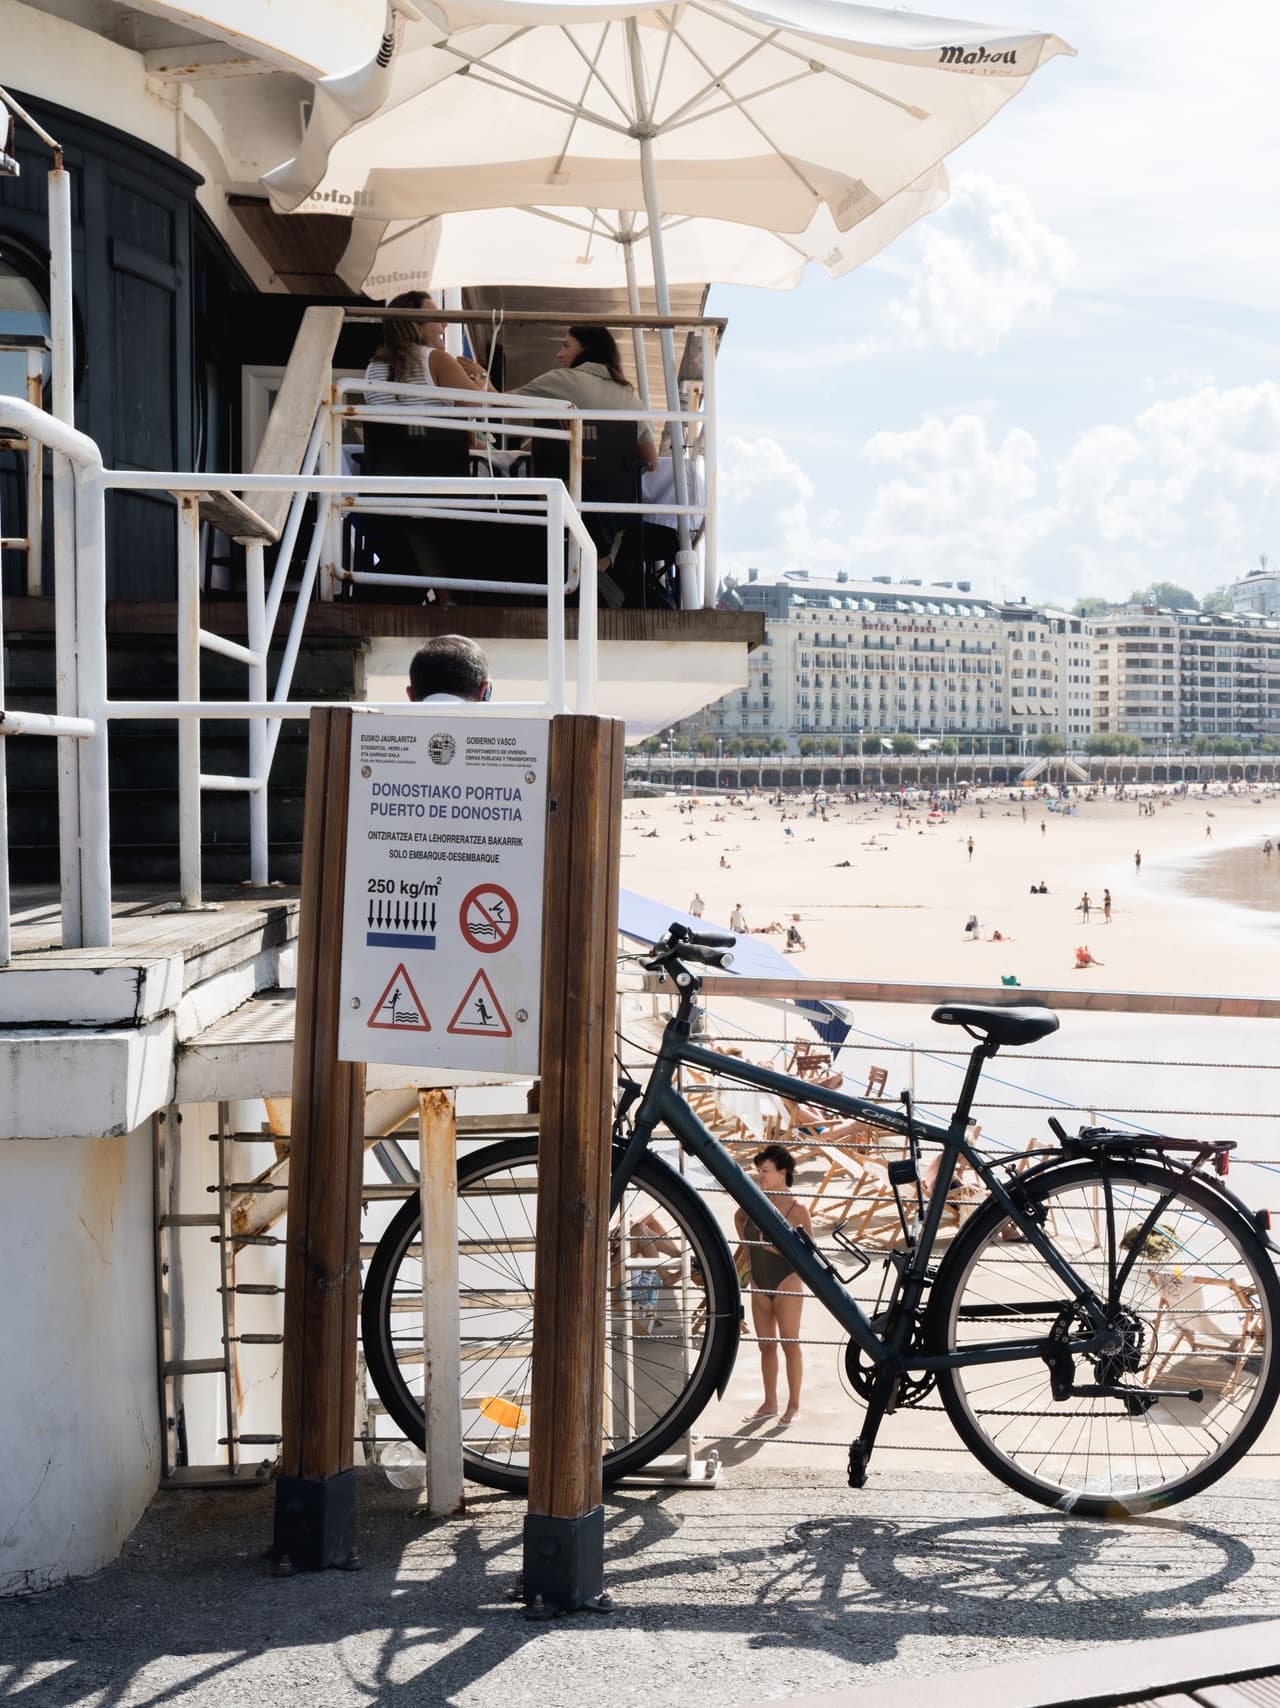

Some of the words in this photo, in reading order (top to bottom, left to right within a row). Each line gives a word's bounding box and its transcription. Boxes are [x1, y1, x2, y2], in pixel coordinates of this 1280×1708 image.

[361, 734, 379, 742] EUSKO
[466, 736, 496, 745] GOBIERNO
[497, 737, 516, 745] VASCO
[372, 783, 462, 799] DONOSTIAKO
[465, 786, 522, 801] PORTUA
[370, 802, 425, 818] PUERTO
[429, 804, 447, 818] DE
[451, 806, 522, 821] DONOSTIA
[368, 830, 413, 842] ONTZIRATZEA
[414, 833, 427, 842] ETA
[428, 833, 486, 845] LEHORRERATZEA
[487, 836, 523, 846] BAKARRIK
[389, 849, 408, 859] SOLO
[408, 850, 500, 864] EMBARQUE-DESEMBARQUE
[368, 878, 395, 894] 250
